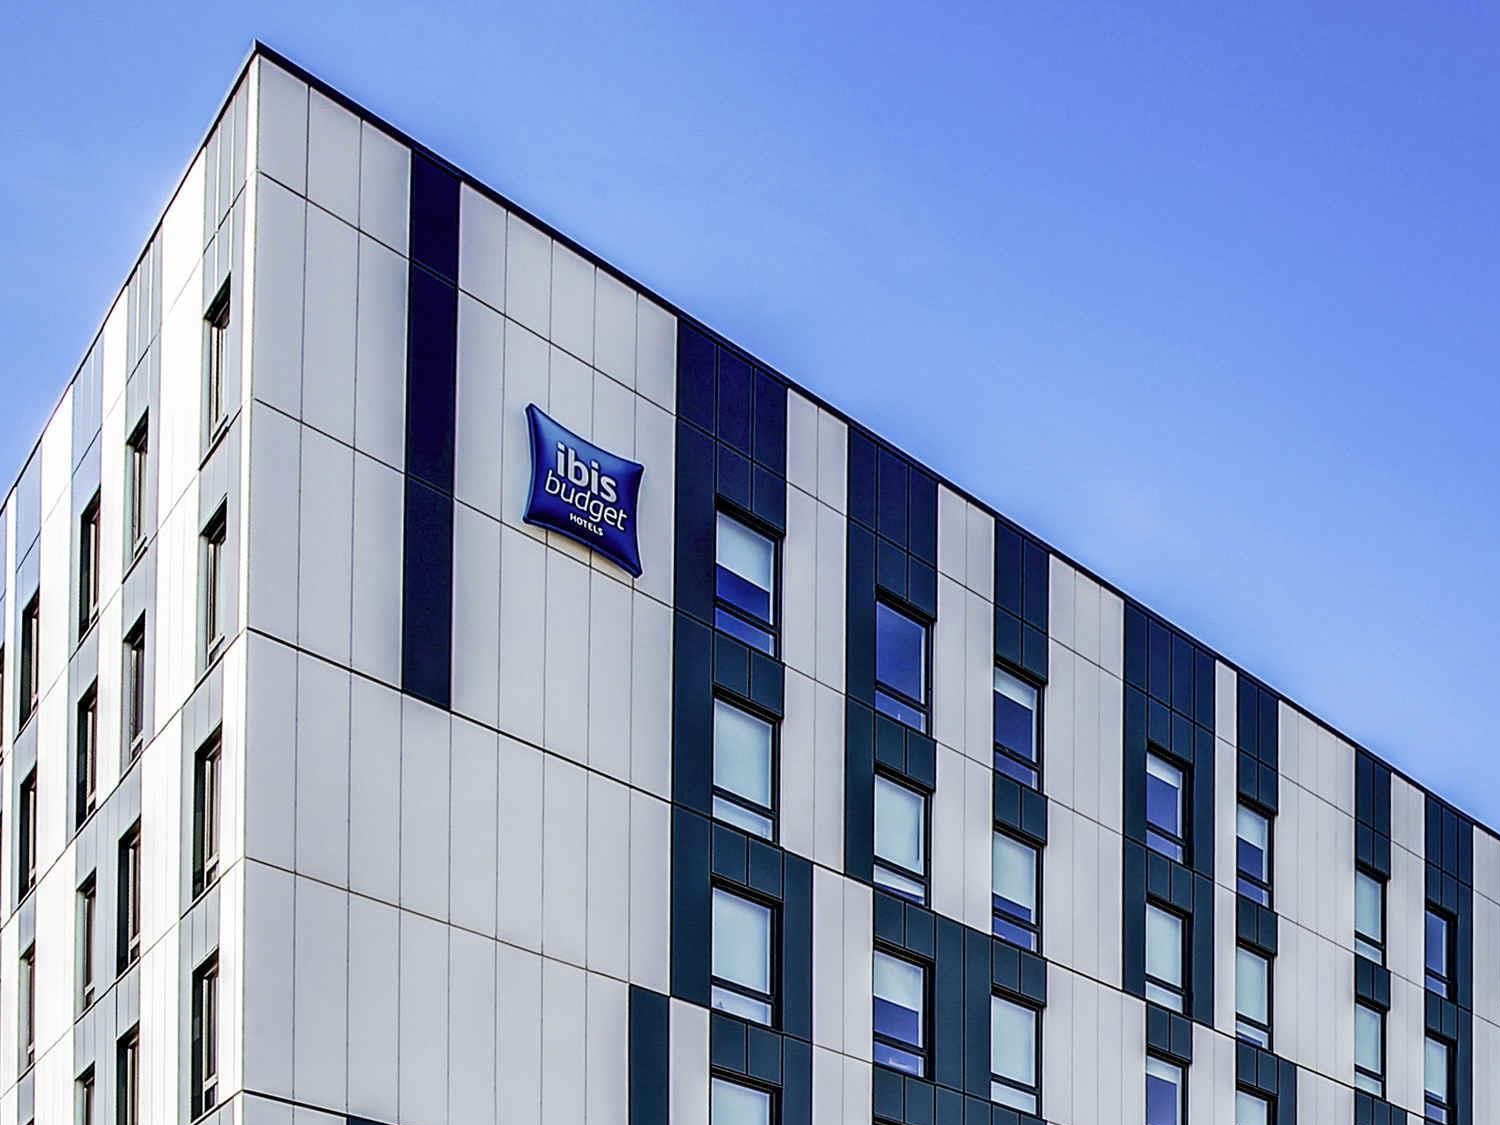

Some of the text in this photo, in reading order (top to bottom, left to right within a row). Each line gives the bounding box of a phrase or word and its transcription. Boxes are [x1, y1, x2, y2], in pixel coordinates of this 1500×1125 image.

[545, 470, 628, 531] budget
[557, 441, 617, 503] ibis
[569, 512, 604, 536] HOTELS
